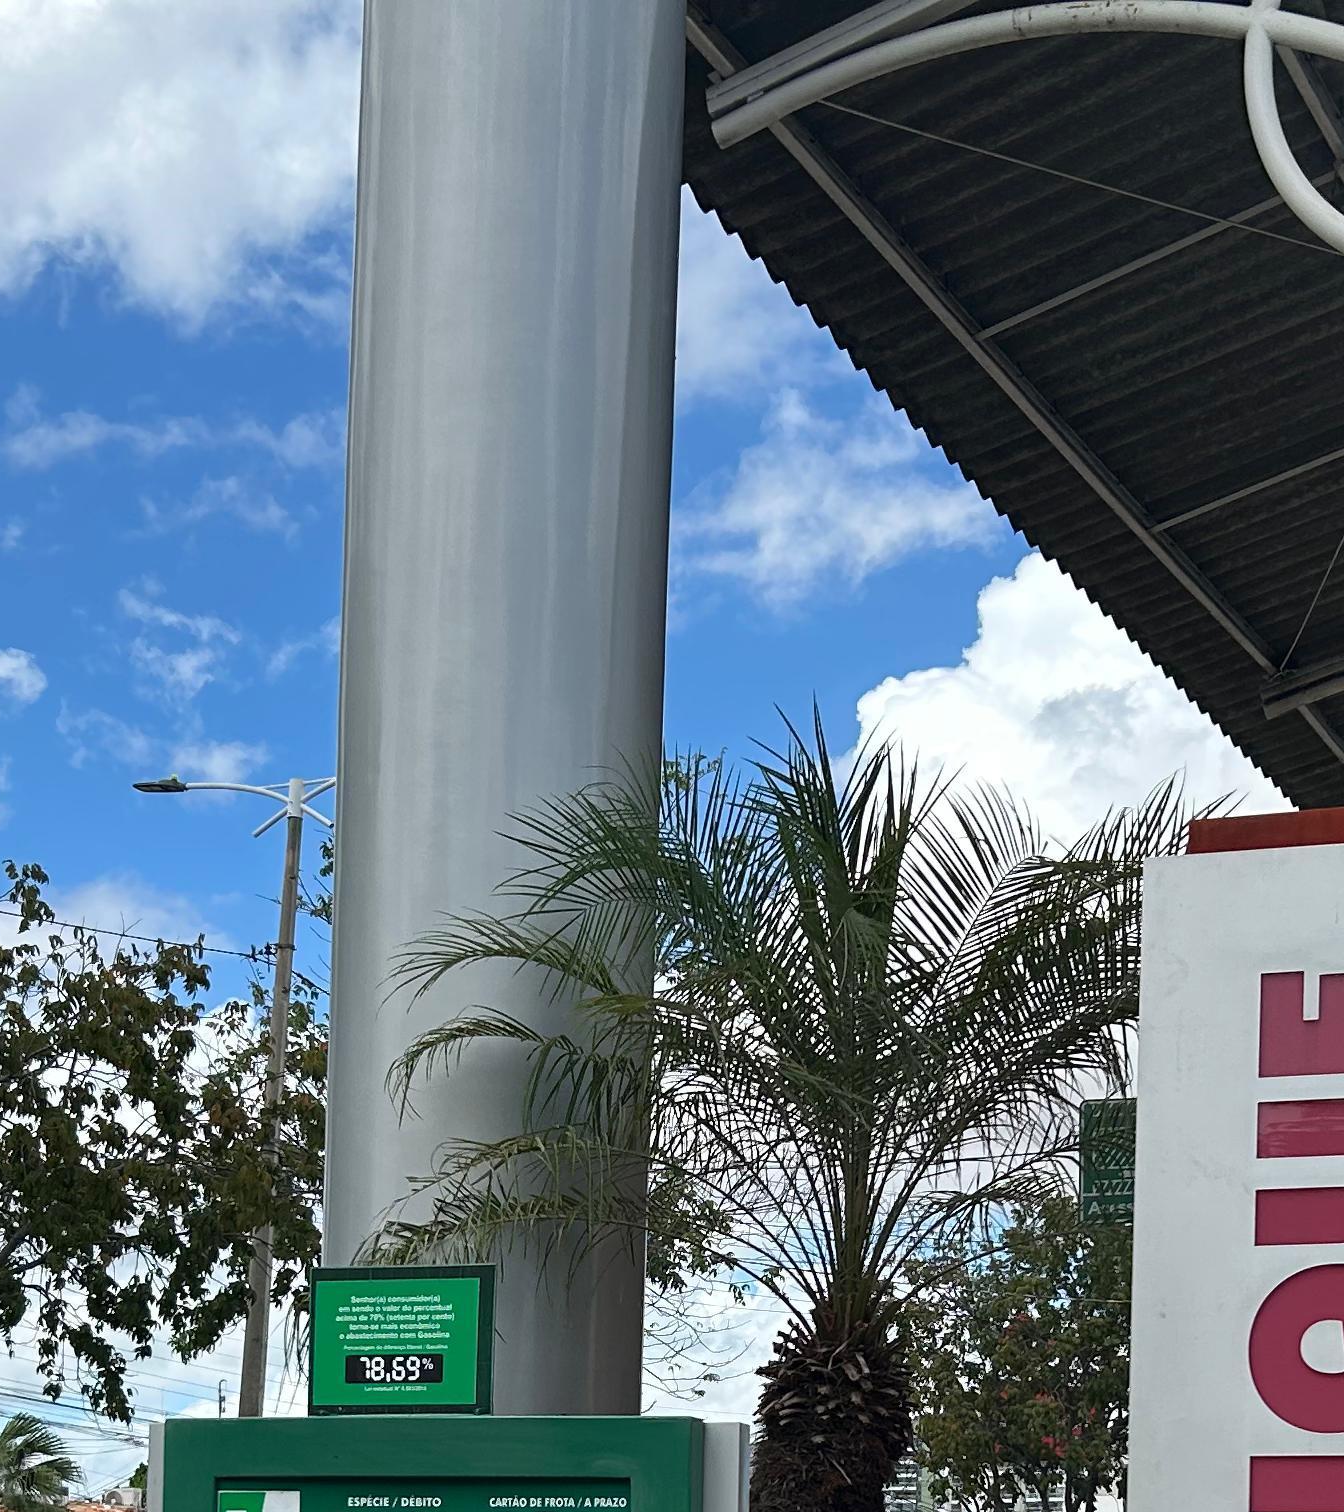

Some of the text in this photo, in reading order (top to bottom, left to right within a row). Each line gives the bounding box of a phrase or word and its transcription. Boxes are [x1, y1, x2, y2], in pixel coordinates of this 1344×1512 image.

[388, 1295, 440, 1303] consumidor(a)
[413, 1304, 452, 1312] percentual
[348, 1495, 390, 1507] ESPÉCIE
[401, 1495, 441, 1507] DÉBITO
[489, 1495, 527, 1508] CARTÃO
[529, 1498, 542, 1507] DE
[544, 1498, 575, 1508] FROTA
[584, 1498, 591, 1507] A
[594, 1497, 627, 1508] PRAZO
